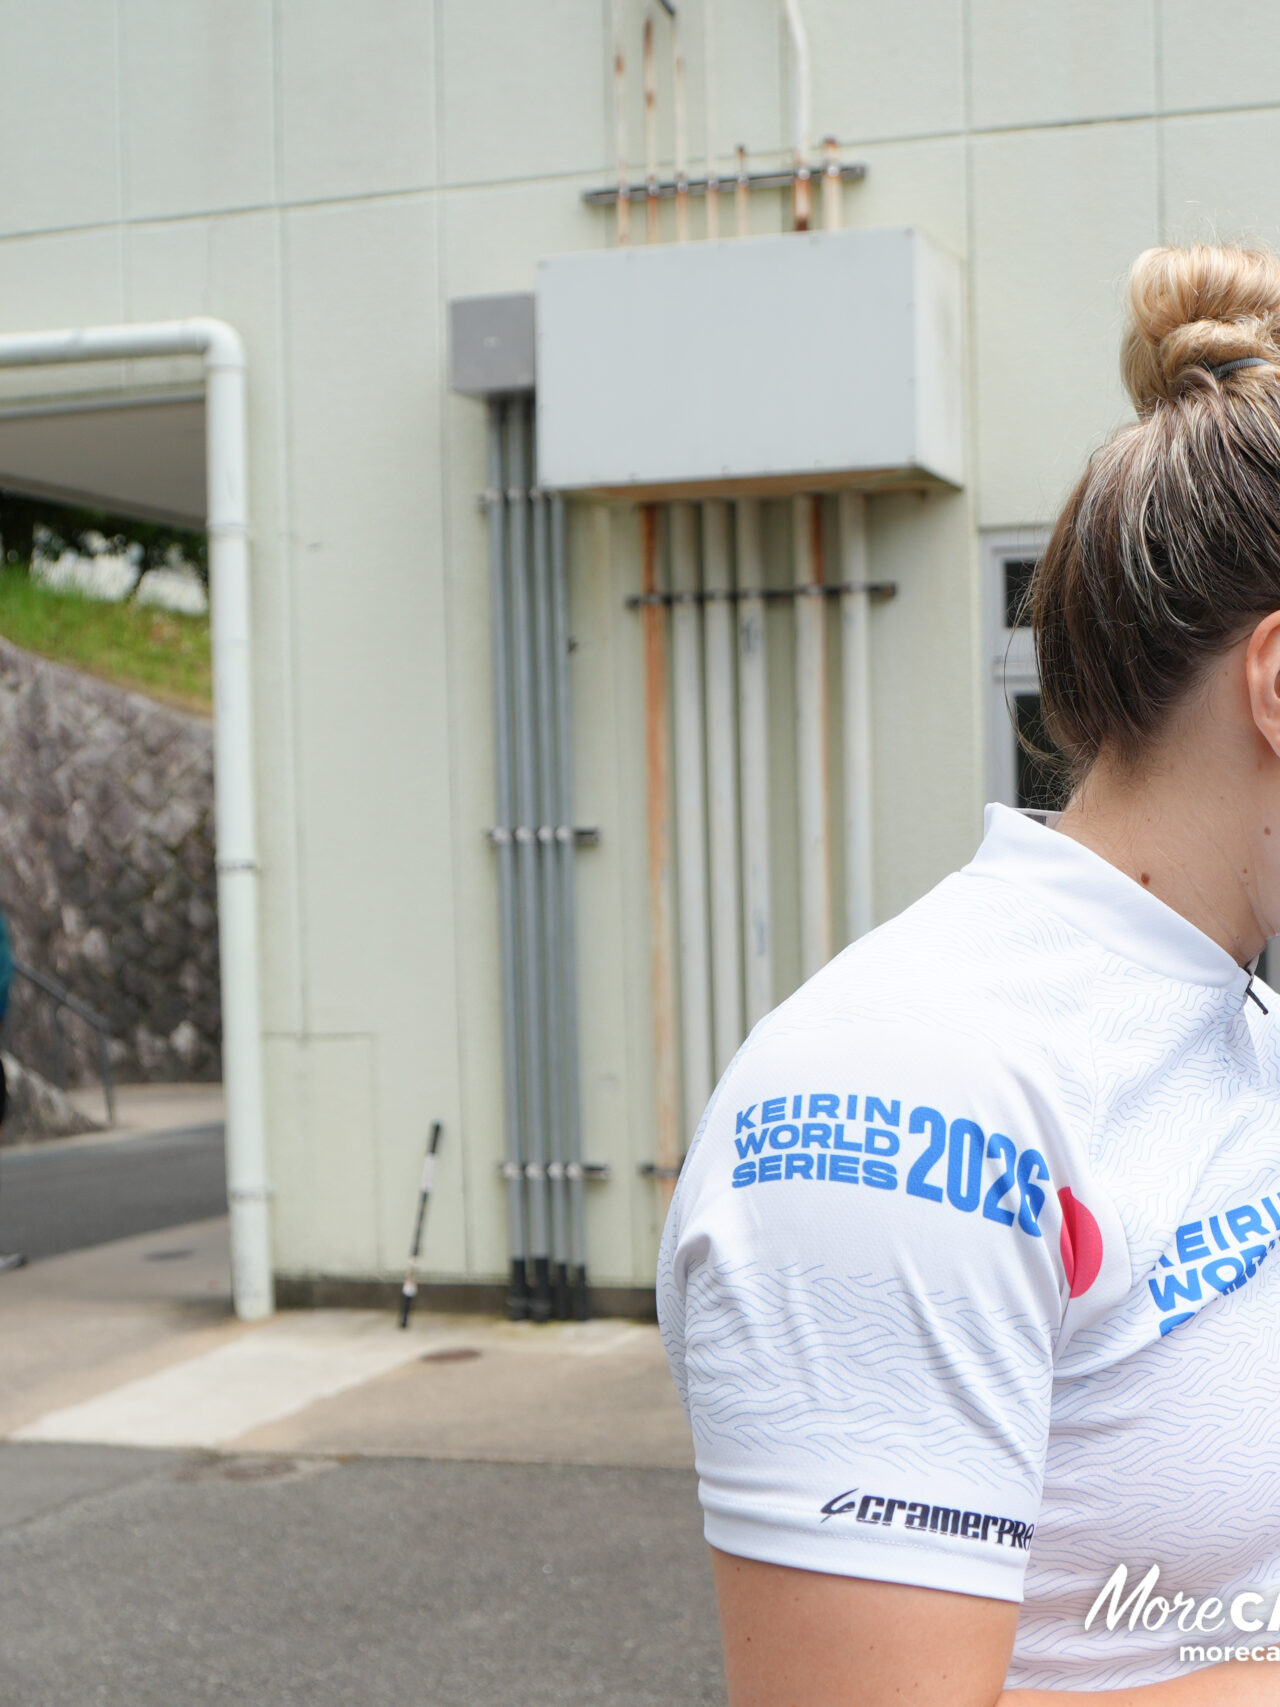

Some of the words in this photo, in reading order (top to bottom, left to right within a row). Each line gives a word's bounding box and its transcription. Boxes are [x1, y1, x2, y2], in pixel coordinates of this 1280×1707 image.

[735, 1093, 901, 1134] KEIRIN
[733, 1122, 901, 1160] WORLD
[731, 1152, 899, 1190] SERIES
[905, 1106, 1050, 1237] 2026
